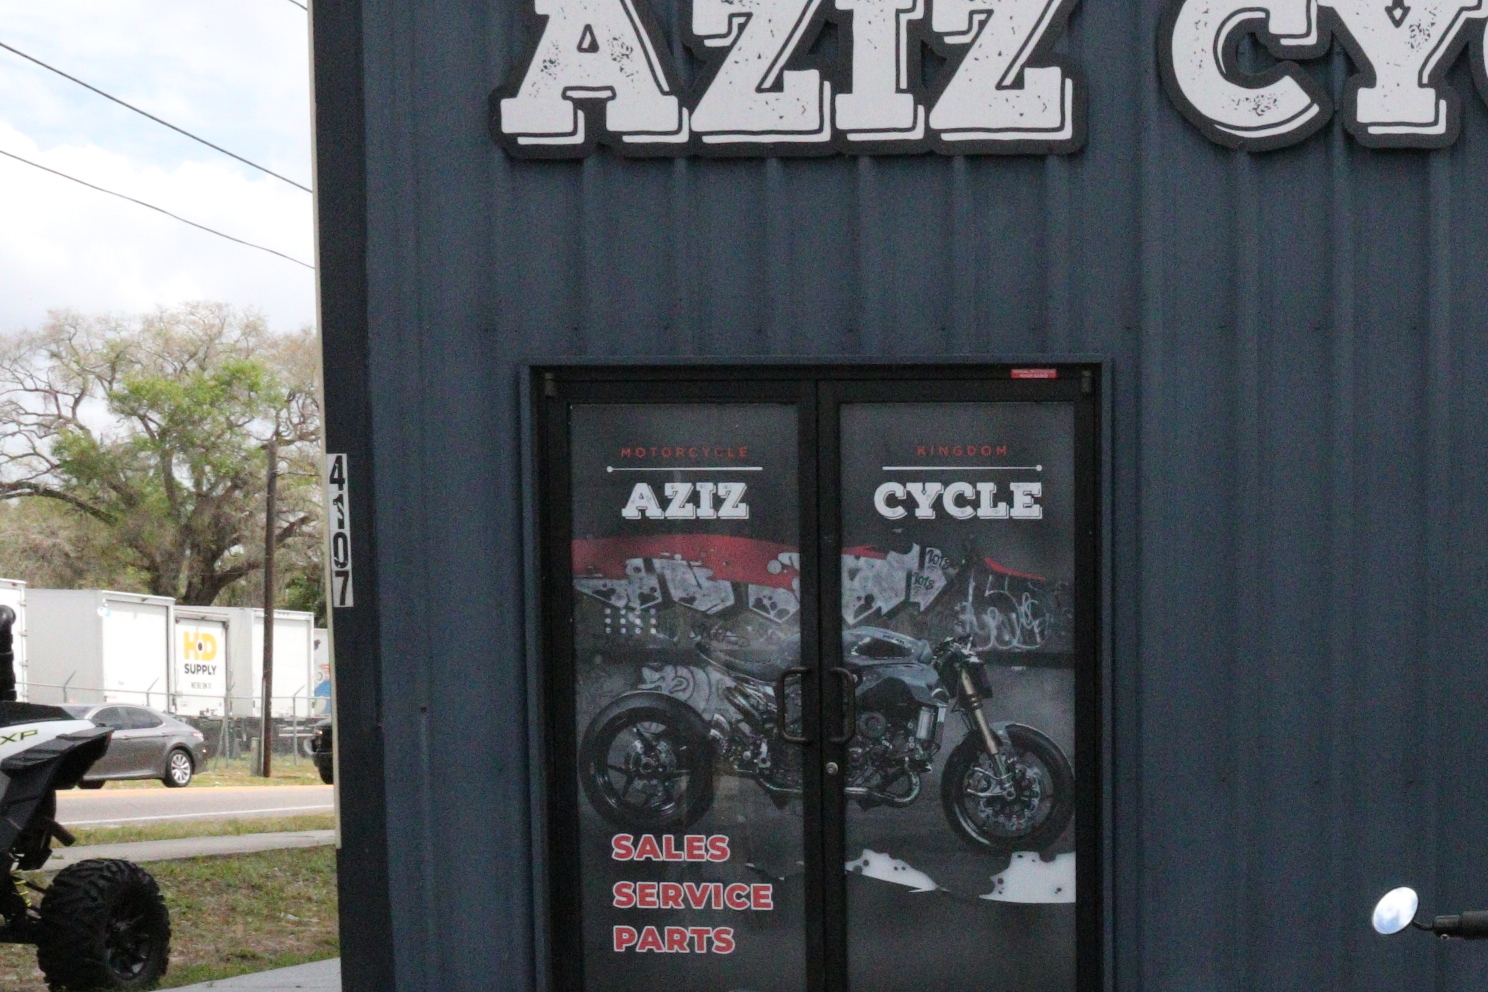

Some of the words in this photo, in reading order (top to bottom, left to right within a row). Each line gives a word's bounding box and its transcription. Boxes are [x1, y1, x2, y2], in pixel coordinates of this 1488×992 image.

[501, 0, 1073, 145] AZIZ
[621, 446, 748, 459] MOTORCYCLE
[917, 445, 1007, 457] KINGDOM
[621, 482, 749, 520] AZIZ
[874, 482, 1043, 520] CYCLE
[183, 631, 218, 661] HD
[184, 663, 217, 676] SUPPLY
[611, 833, 730, 862] SALES
[613, 881, 773, 910] SERVICE
[613, 925, 735, 954] PARTS
